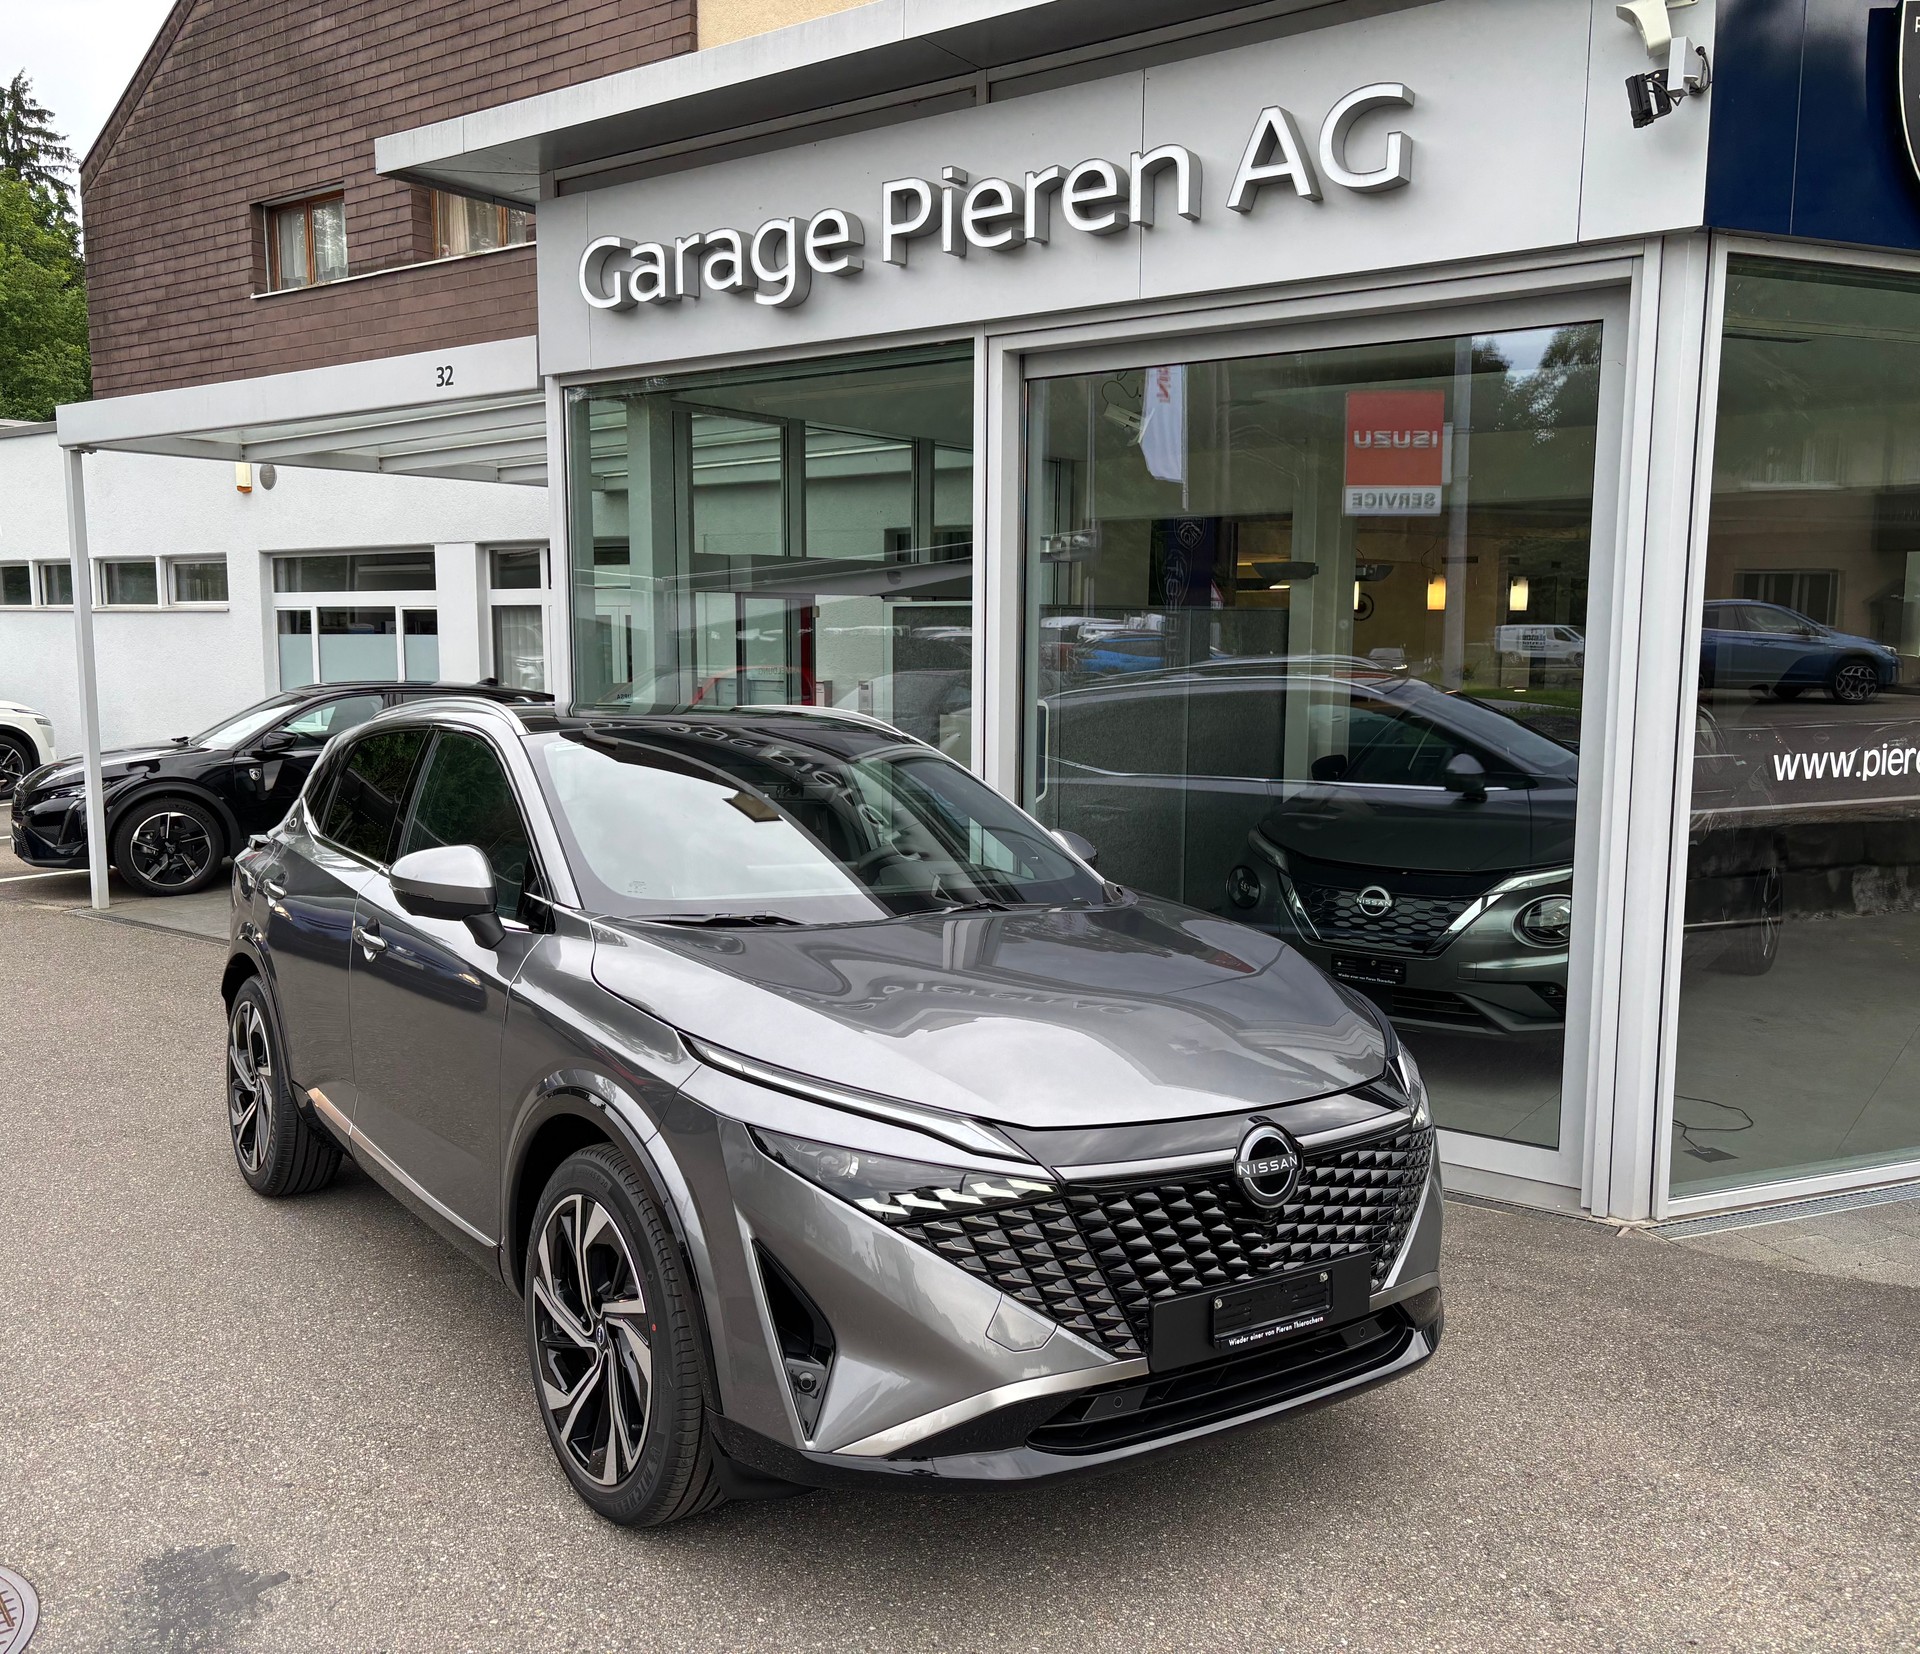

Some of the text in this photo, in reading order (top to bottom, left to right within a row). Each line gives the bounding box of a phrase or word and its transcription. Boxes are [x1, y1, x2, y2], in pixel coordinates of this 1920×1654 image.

[578, 82, 1415, 309] Garage Pieren AG
[436, 365, 454, 388] 32
[1356, 897, 1392, 907] NISSAN
[1238, 1155, 1298, 1176] NISSAN
[1228, 1336, 1249, 1346] Wieder
[1250, 1332, 1264, 1341] einer
[1265, 1329, 1275, 1337] von
[1276, 1324, 1293, 1334] Pieren
